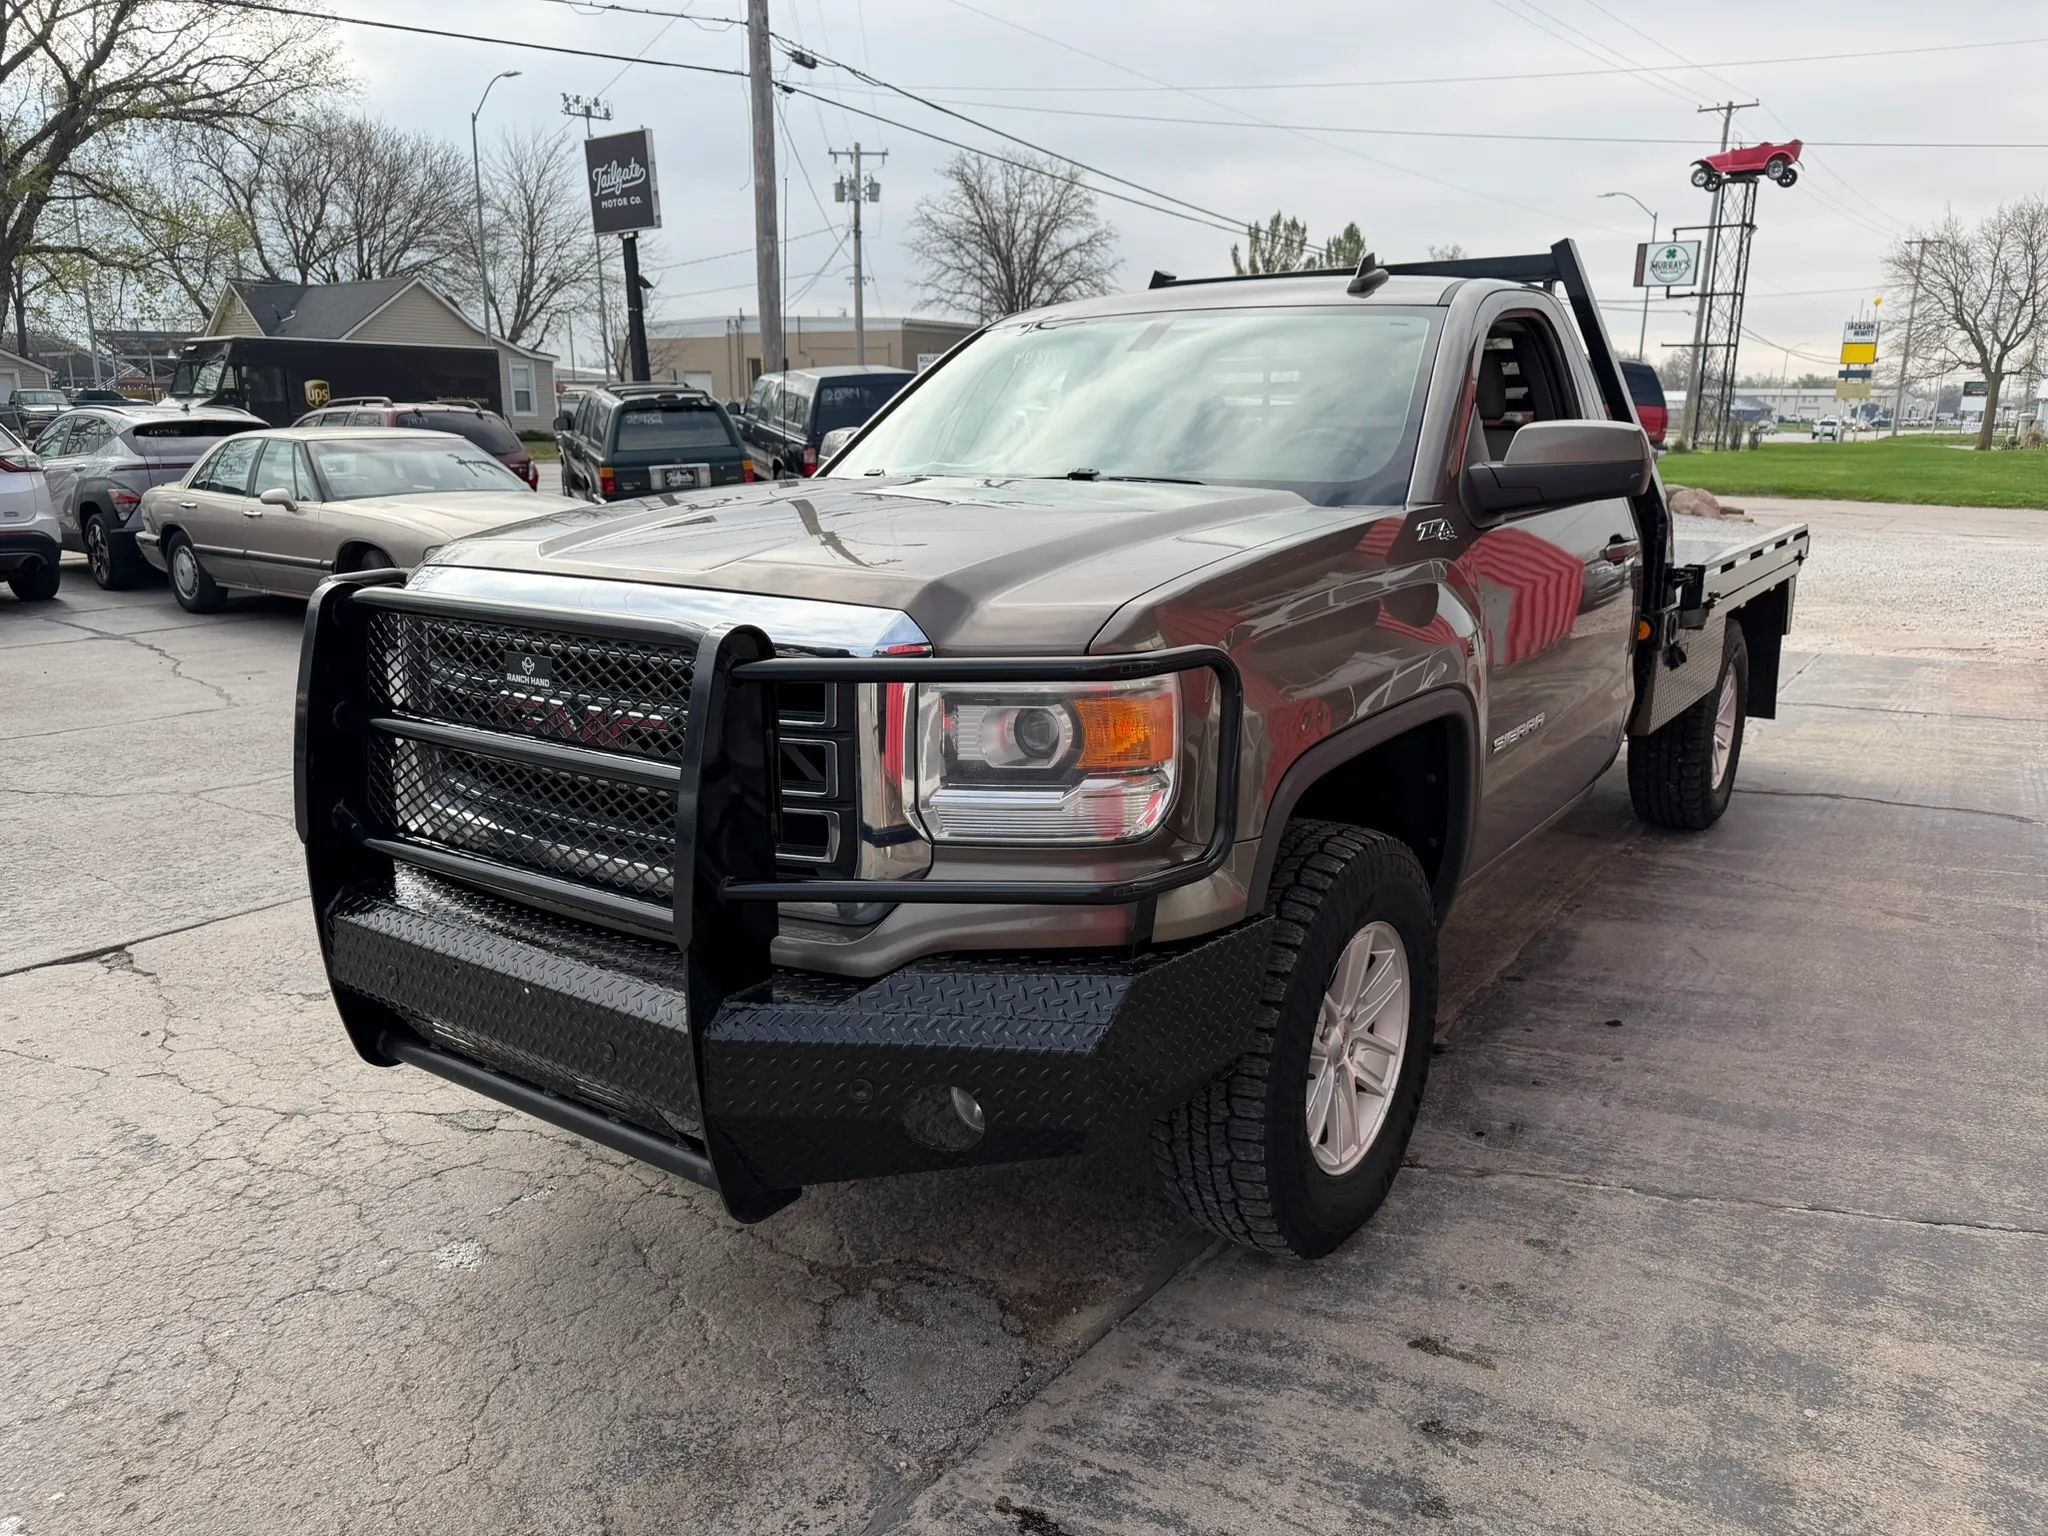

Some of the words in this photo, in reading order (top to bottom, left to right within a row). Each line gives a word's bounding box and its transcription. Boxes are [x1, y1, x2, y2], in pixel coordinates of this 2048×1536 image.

[592, 157, 646, 197] Tailgate
[601, 198, 628, 208] MOTOR
[629, 196, 643, 205] CO.
[1650, 260, 1692, 271] MURRAY'S
[1847, 320, 1875, 330] JACKSON
[308, 388, 329, 406] ups
[506, 672, 530, 685] RANCH
[530, 676, 550, 688] HAND
[1493, 711, 1545, 754] SIERRA
